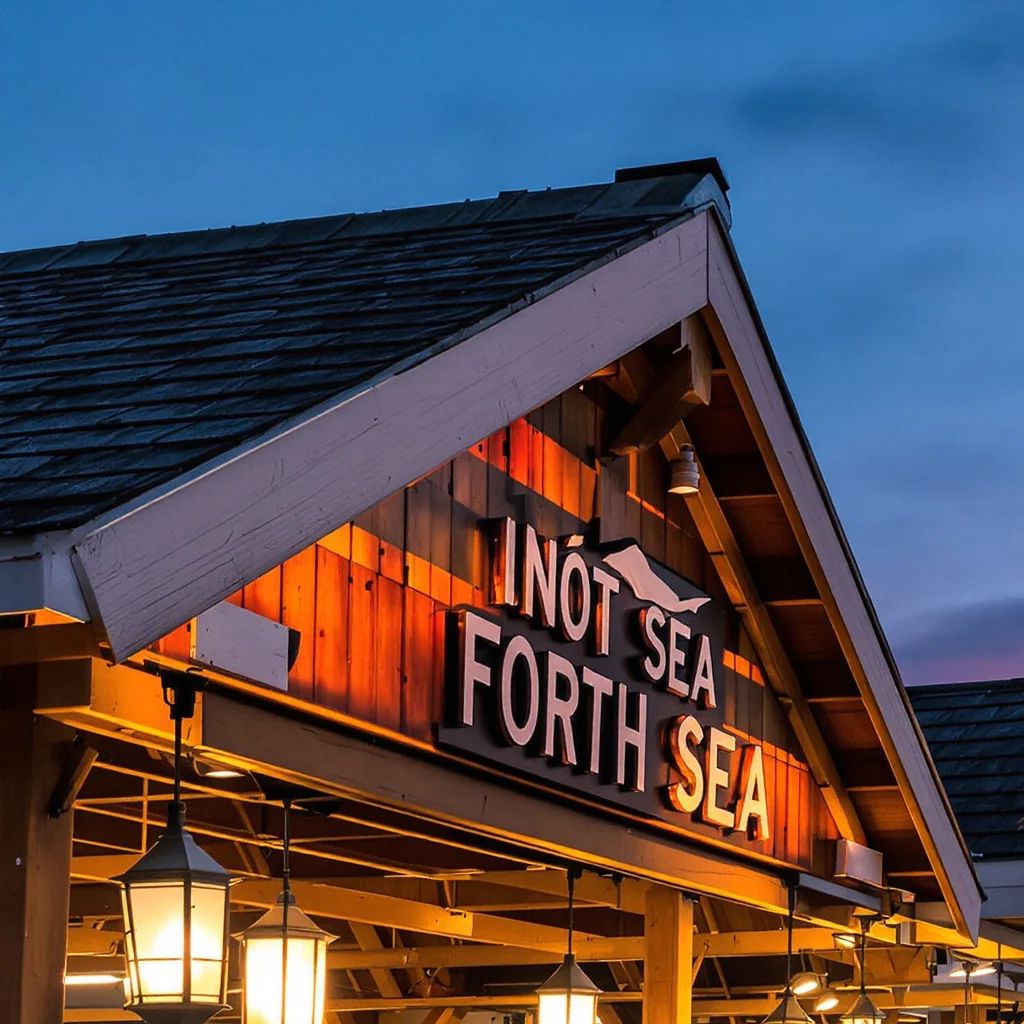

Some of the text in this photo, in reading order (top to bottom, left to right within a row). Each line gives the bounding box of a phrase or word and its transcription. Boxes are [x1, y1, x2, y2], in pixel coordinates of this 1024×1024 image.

[461, 611, 770, 841] FORTH SEA
[640, 605, 717, 708] SEA
